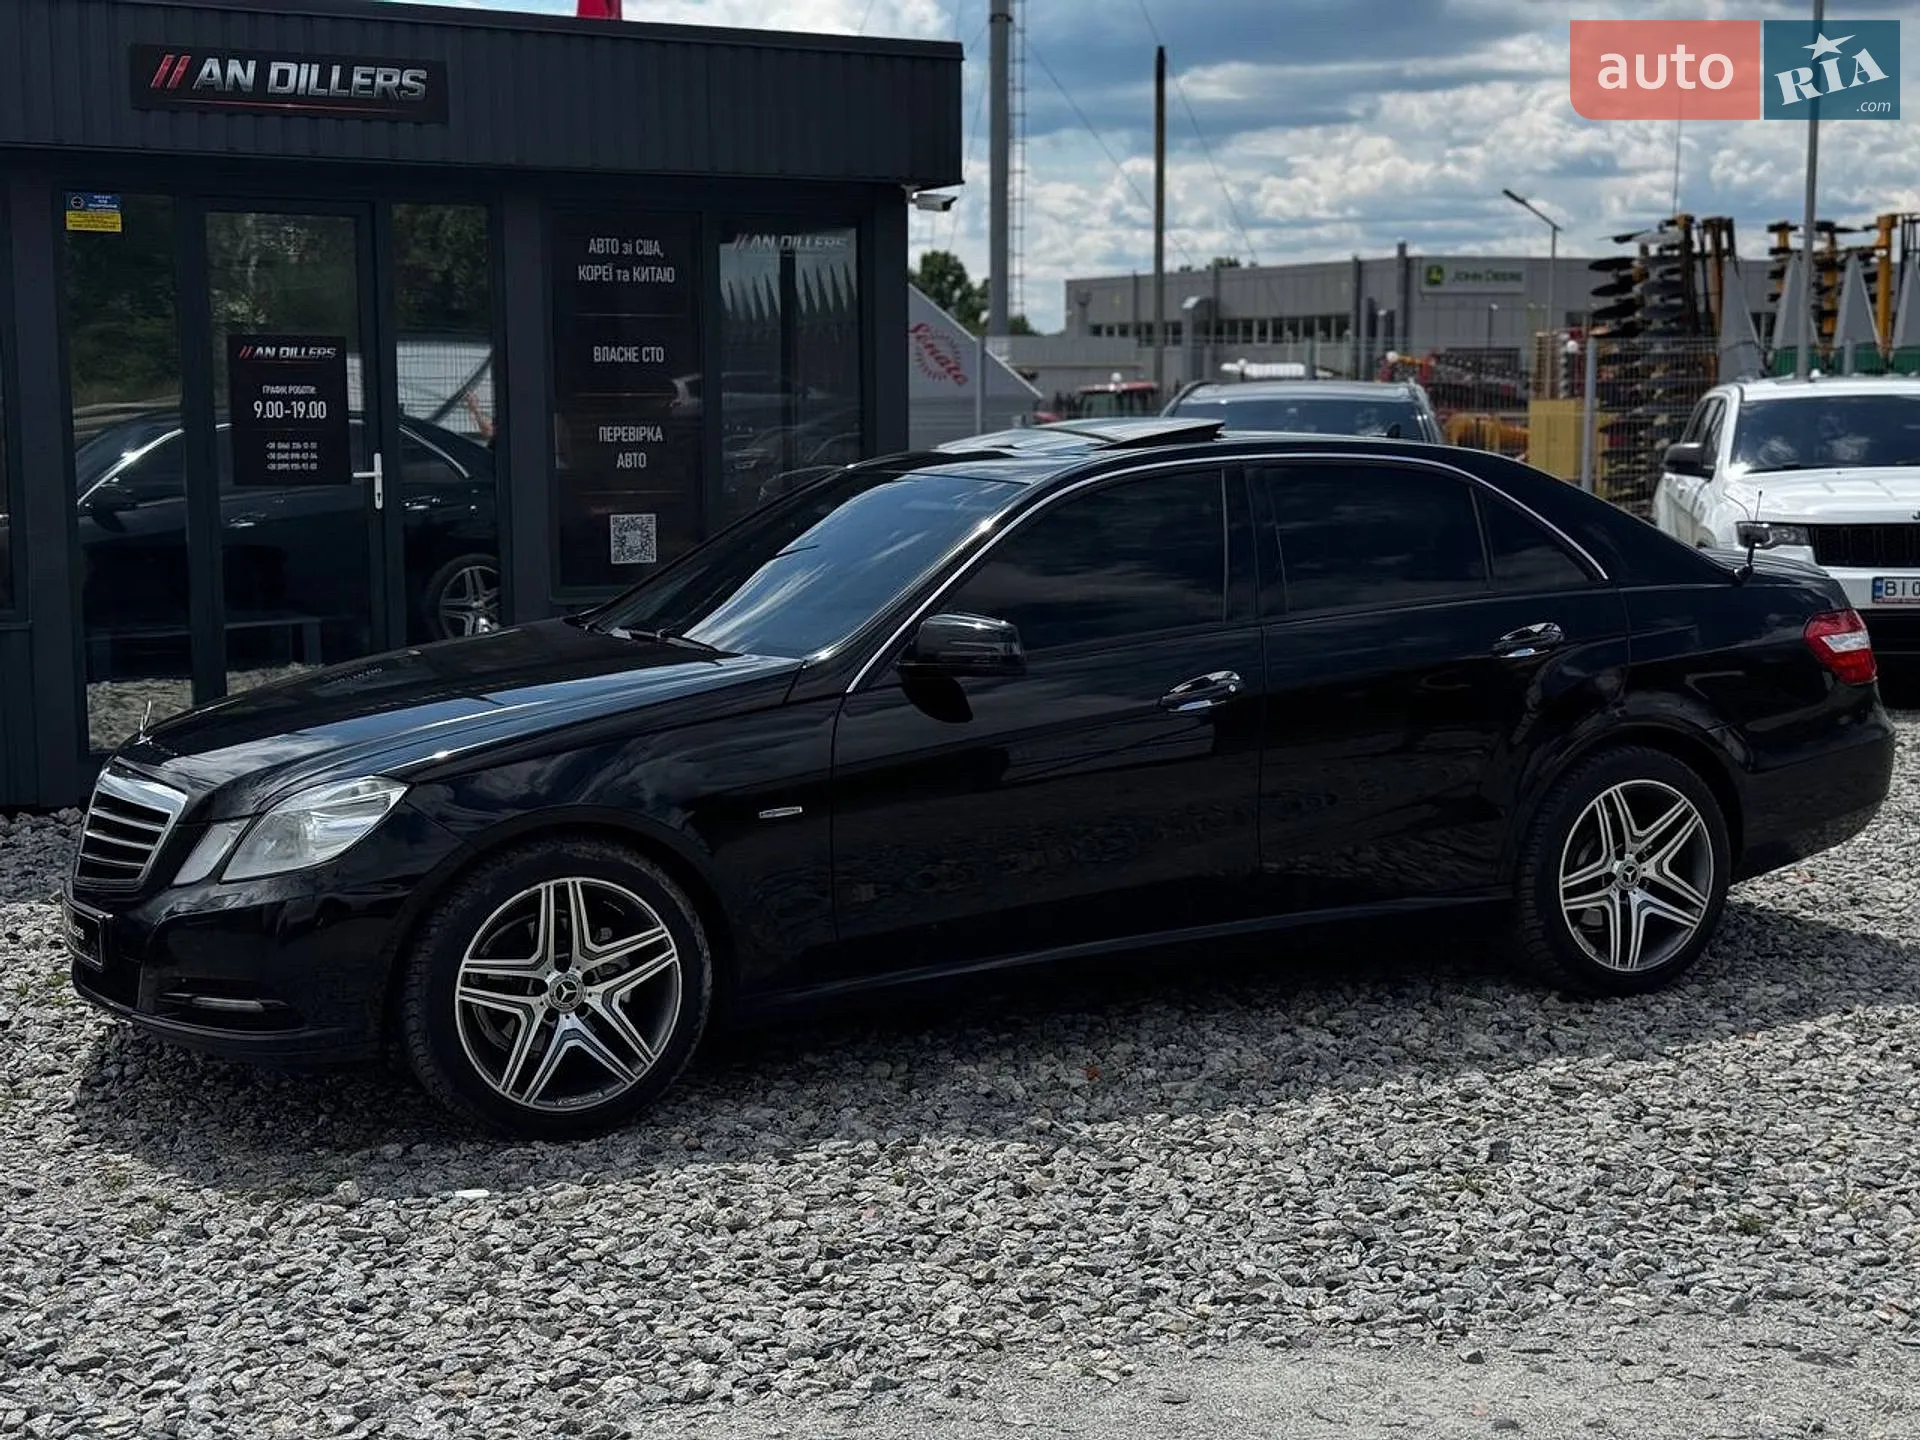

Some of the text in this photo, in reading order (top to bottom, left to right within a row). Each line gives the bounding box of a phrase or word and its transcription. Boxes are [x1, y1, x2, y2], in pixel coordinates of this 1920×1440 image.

[192, 58, 428, 101] AN DILLERS
[588, 237, 664, 258] АВТО зі США,
[750, 234, 776, 250] AN
[578, 262, 675, 282] КОРЕЇ та КИТАЮ
[253, 346, 337, 359] AN DILLERS
[593, 346, 665, 362] ВЛАСНЕ СТО
[253, 400, 327, 419] 9.00-19.00
[599, 425, 664, 442] ПЕРЕВІРКА
[616, 451, 647, 468] АВТО
